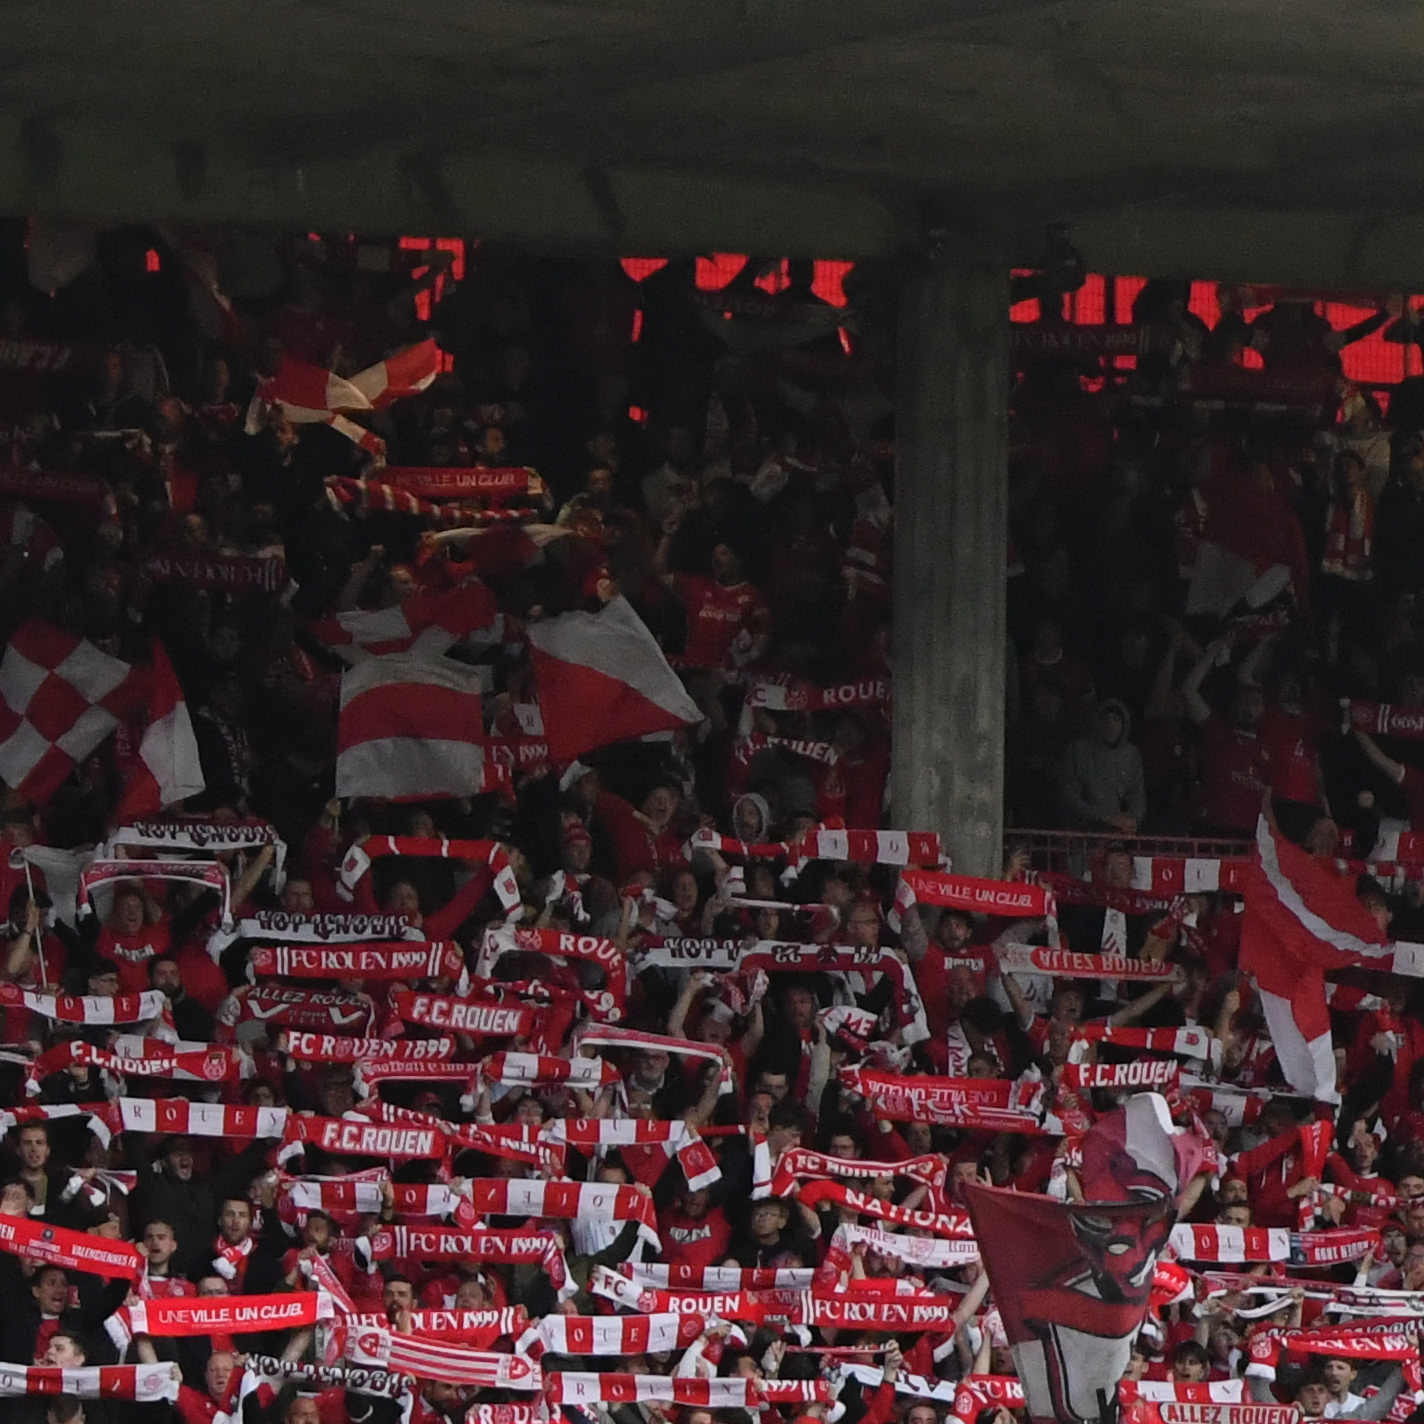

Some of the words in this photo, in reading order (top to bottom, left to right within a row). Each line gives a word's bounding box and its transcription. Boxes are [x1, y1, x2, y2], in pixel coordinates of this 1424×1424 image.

[939, 882, 972, 901] VILLE
[291, 950, 318, 968] FC
[321, 950, 389, 969] ROUEN
[392, 951, 427, 968] 1899
[249, 987, 307, 1004] ALLEZ
[412, 997, 523, 1033] F.C.ROUEN
[288, 1031, 316, 1054] FC
[404, 1038, 451, 1059] 1899
[1079, 1060, 1177, 1087] F.C.ROUEN
[322, 1121, 434, 1154] F.C.ROUEN
[410, 1232, 437, 1254] FC
[439, 1233, 507, 1256] ROUEN
[511, 1236, 550, 1255] 1899
[604, 1272, 627, 1298] FC
[668, 1296, 741, 1314] ROUEN
[159, 1310, 187, 1325] UNE
[189, 1307, 230, 1324] VILLE
[235, 1306, 258, 1321] UN
[259, 1303, 305, 1320] CLUB.
[462, 1308, 500, 1328] 1899
[816, 1300, 840, 1320] FC
[843, 1303, 910, 1323] ROUEN
[912, 1305, 949, 1323] 1899
[1166, 1404, 1223, 1424] ALLEZ
